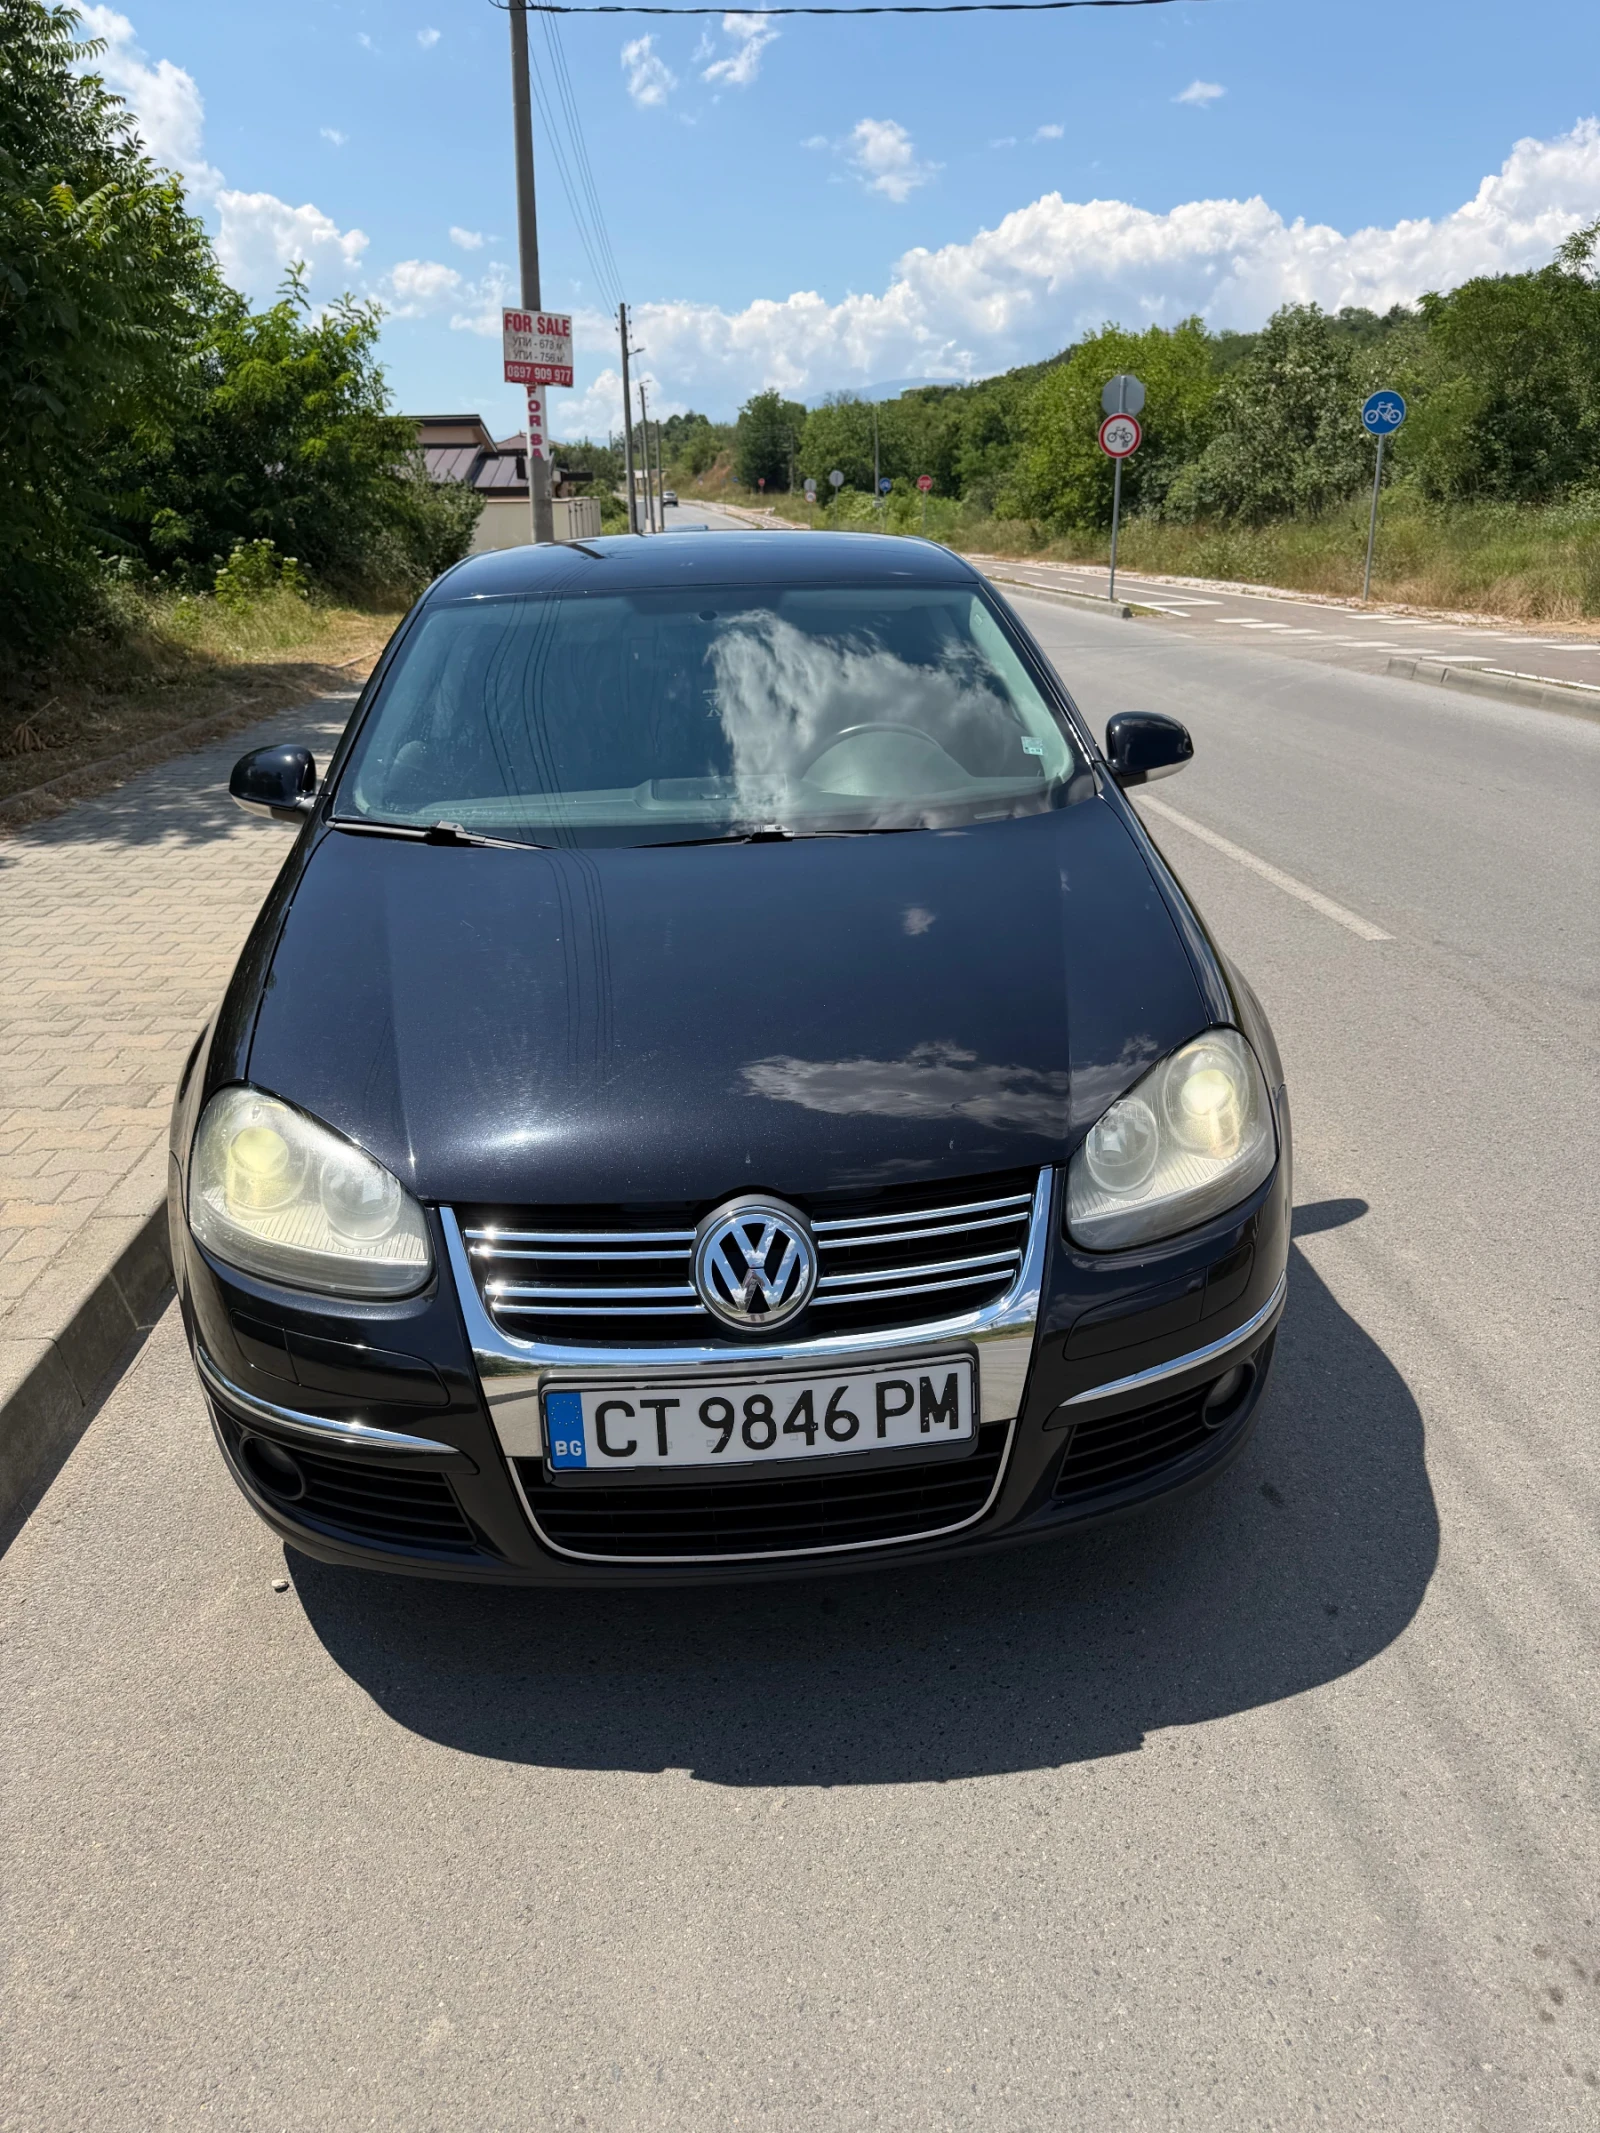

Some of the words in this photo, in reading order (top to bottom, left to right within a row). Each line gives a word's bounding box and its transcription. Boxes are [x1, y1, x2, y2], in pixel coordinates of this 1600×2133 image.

[505, 313, 532, 333] FOR
[537, 316, 570, 337] SALE
[507, 365, 532, 378] 0897
[534, 367, 552, 380] 909
[554, 369, 571, 382] 977
[526, 385, 542, 427] FOR
[595, 1398, 680, 1458] CT
[698, 1385, 860, 1454] 9846
[874, 1372, 959, 1439] PM
[555, 1440, 582, 1456] BG
